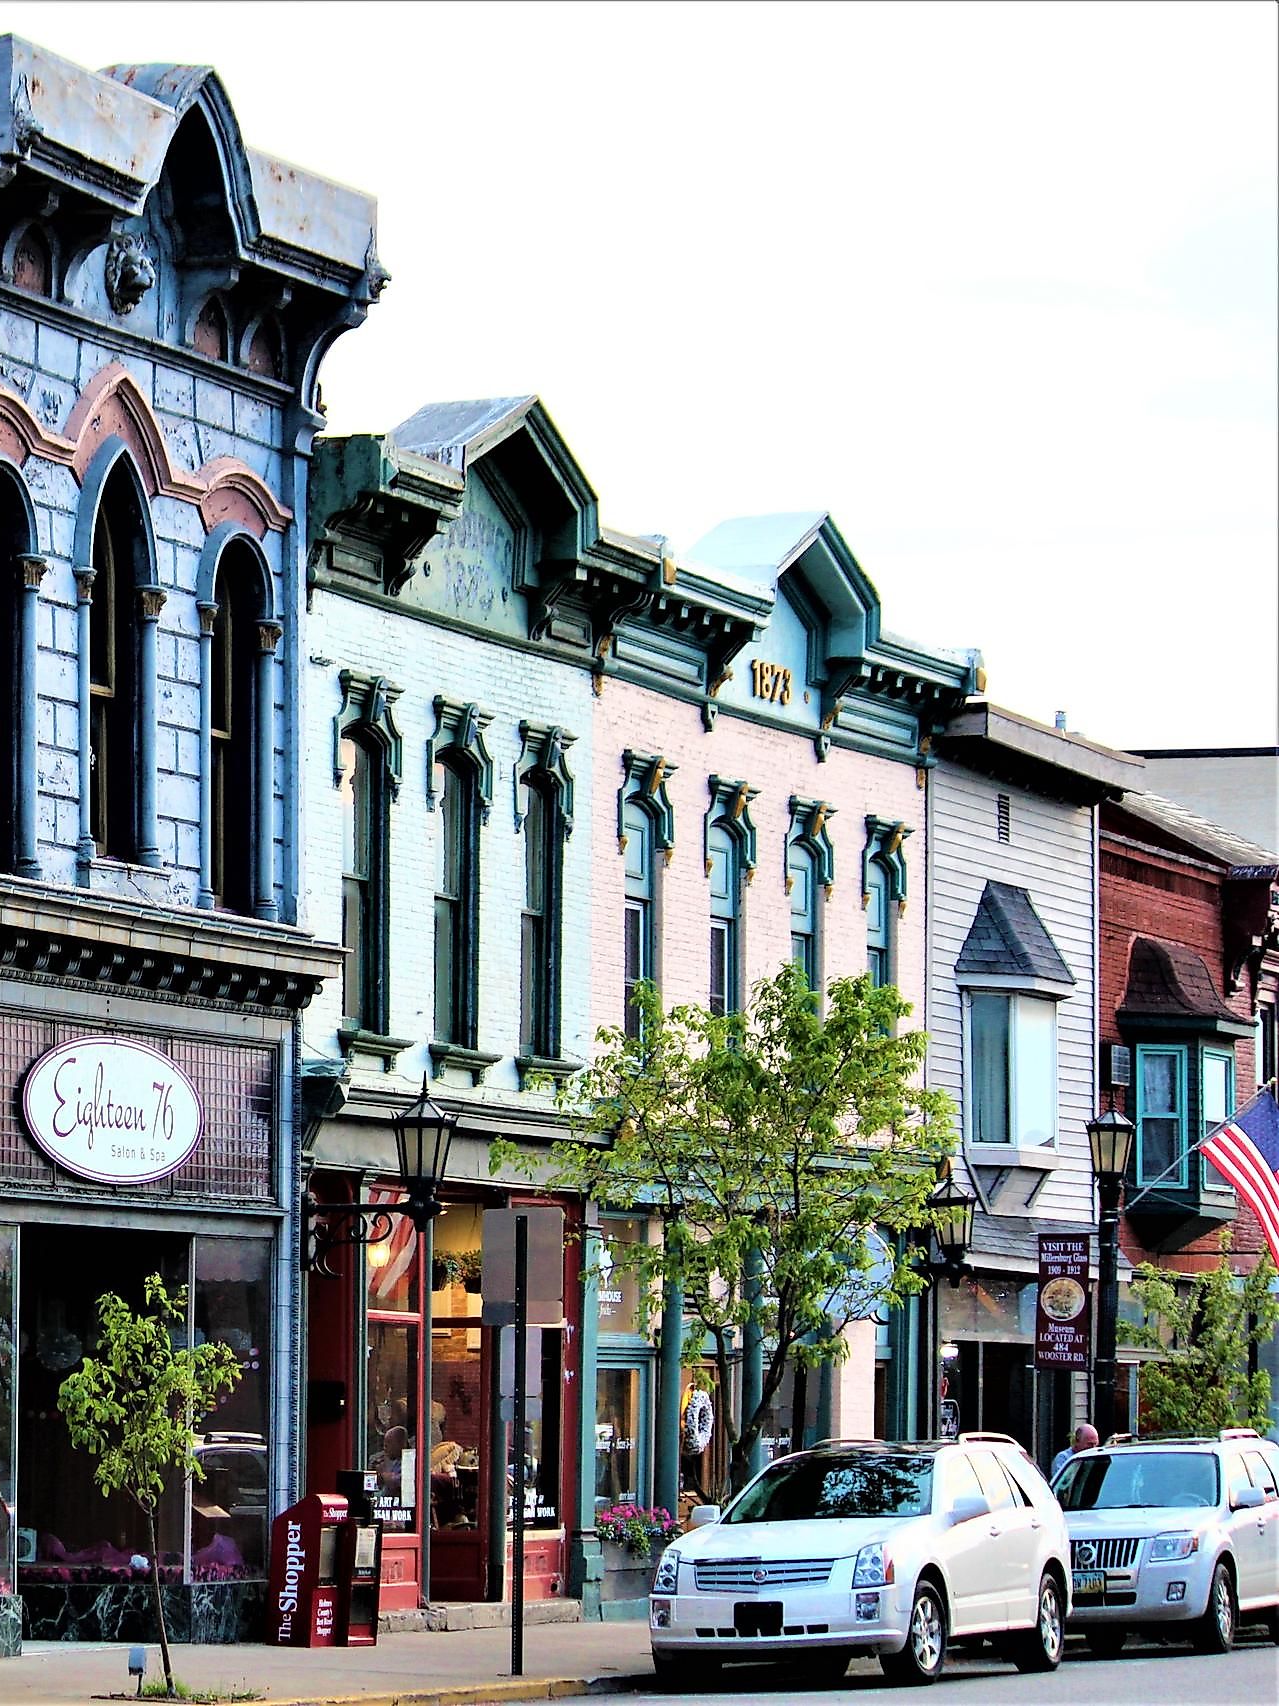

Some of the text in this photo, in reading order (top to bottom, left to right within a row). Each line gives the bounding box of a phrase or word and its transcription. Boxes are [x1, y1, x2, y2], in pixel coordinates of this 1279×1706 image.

[751, 659, 791, 705] 1873
[53, 1057, 174, 1150] Eighteen 76
[111, 1144, 166, 1162] Salon & Spa
[1042, 1242, 1084, 1251] VISIT THE
[1040, 1252, 1088, 1264] Millersburg Glass
[1048, 1323, 1075, 1333] Museum
[1040, 1333, 1084, 1343] LOCATED AT
[1053, 1343, 1069, 1351] 484
[1038, 1351, 1072, 1361] WOOSTER
[329, 1507, 348, 1520] Shopper
[391, 1510, 412, 1520] WORK
[537, 1506, 556, 1517] WORK
[278, 1520, 306, 1641] The Shopper
